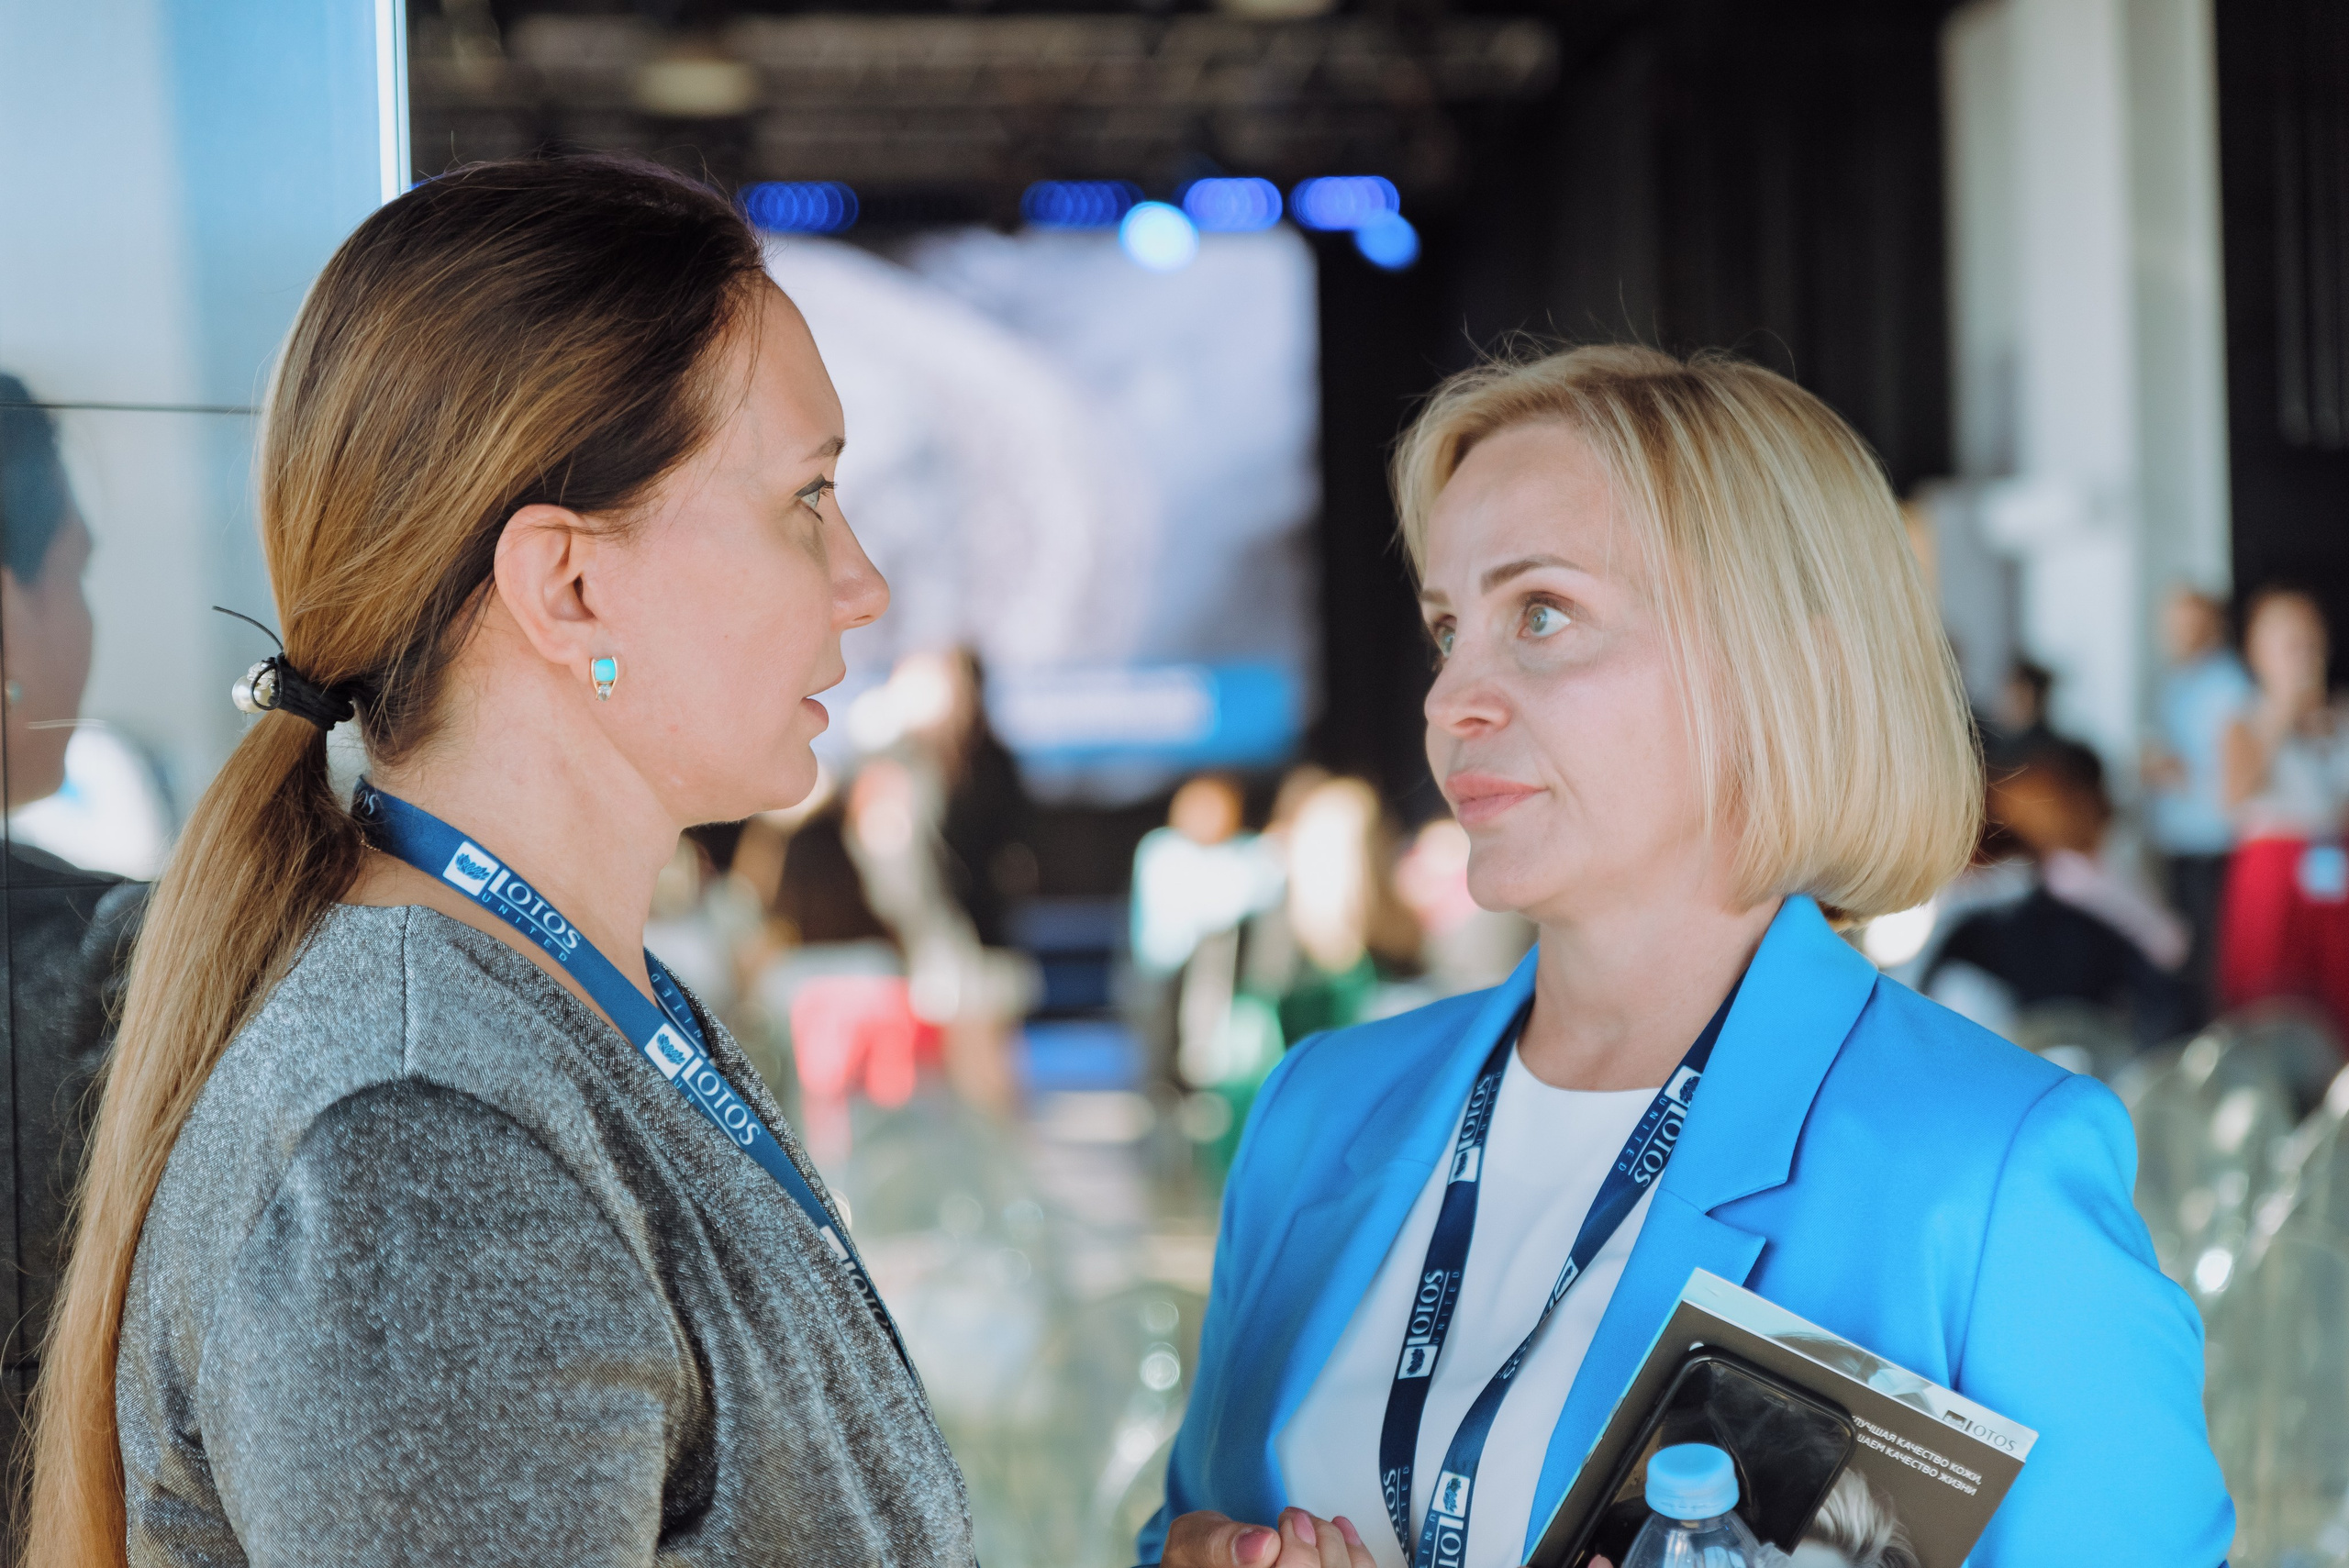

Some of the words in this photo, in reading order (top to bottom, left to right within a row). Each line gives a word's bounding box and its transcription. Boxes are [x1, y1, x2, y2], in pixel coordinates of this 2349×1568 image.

[481, 892, 569, 962] UNITED
[488, 868, 581, 951] LOTOS
[650, 973, 703, 1040] NITED
[681, 1057, 761, 1146] LOTOS
[1618, 1097, 1668, 1173] UNITED
[1634, 1103, 1688, 1188] LOTOS
[1407, 1269, 1445, 1346] LOTOS
[1432, 1271, 1460, 1344] UNITED
[1852, 1416, 1898, 1443] ЛУЧШАЯ
[1896, 1437, 1950, 1468] КАЧЕСТВО
[1948, 1462, 1982, 1485] КОЖИ,
[1885, 1447, 1939, 1477] КАЧЕСТВО
[1937, 1472, 1977, 1496] ЖИЗНИ
[1438, 1515, 1464, 1568] LOT
